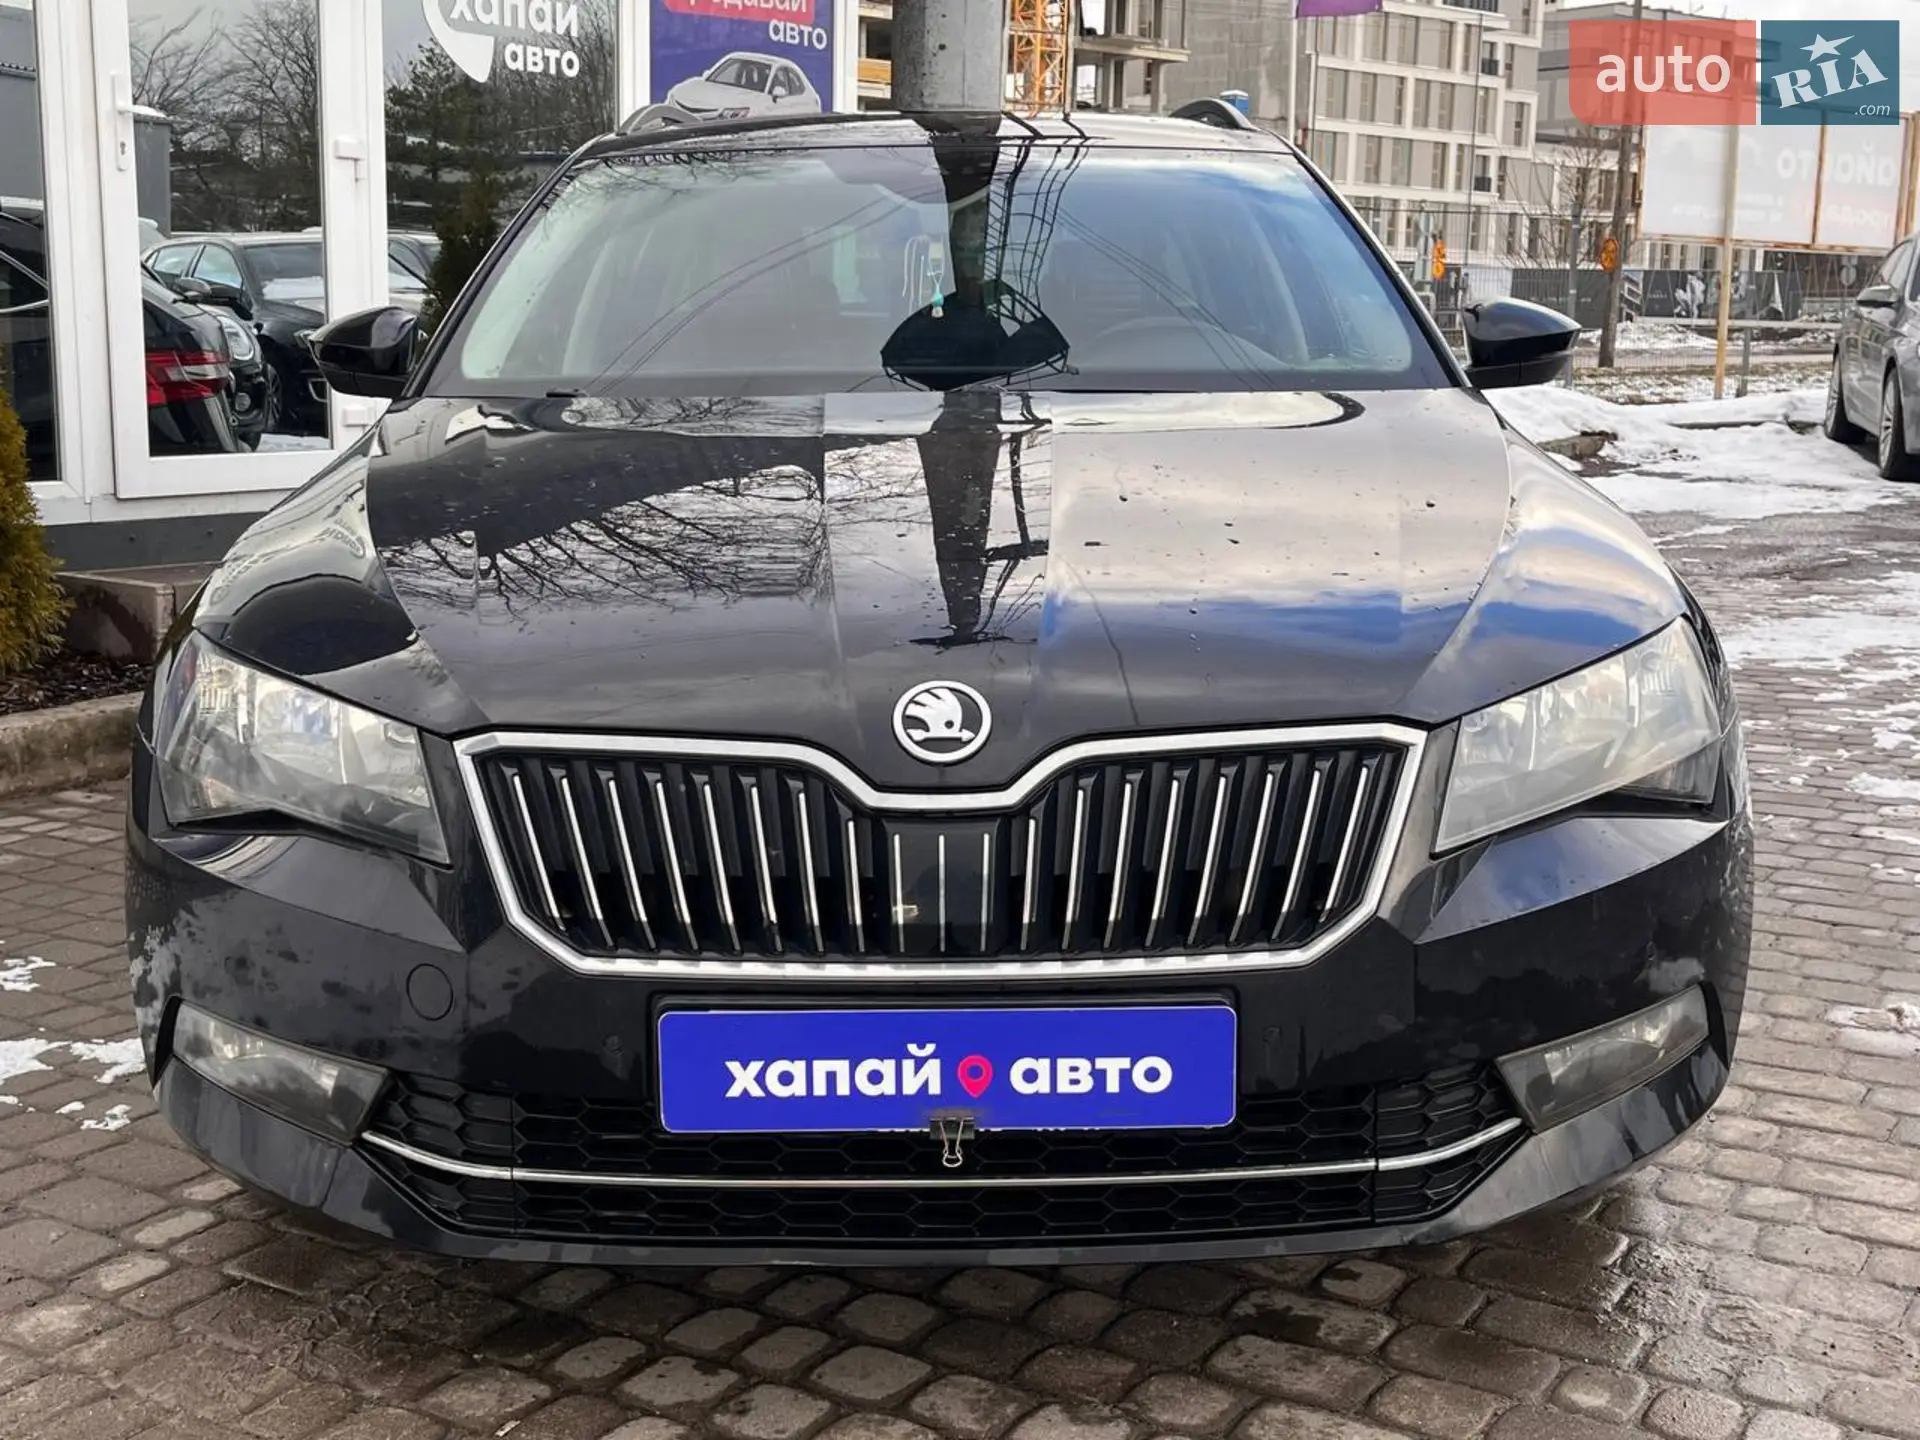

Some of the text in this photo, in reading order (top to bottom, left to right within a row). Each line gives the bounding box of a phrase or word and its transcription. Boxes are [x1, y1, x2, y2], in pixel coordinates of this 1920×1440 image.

[768, 19, 827, 50] авто
[504, 42, 580, 77] авто
[724, 1043, 1173, 1098] хапай авто
